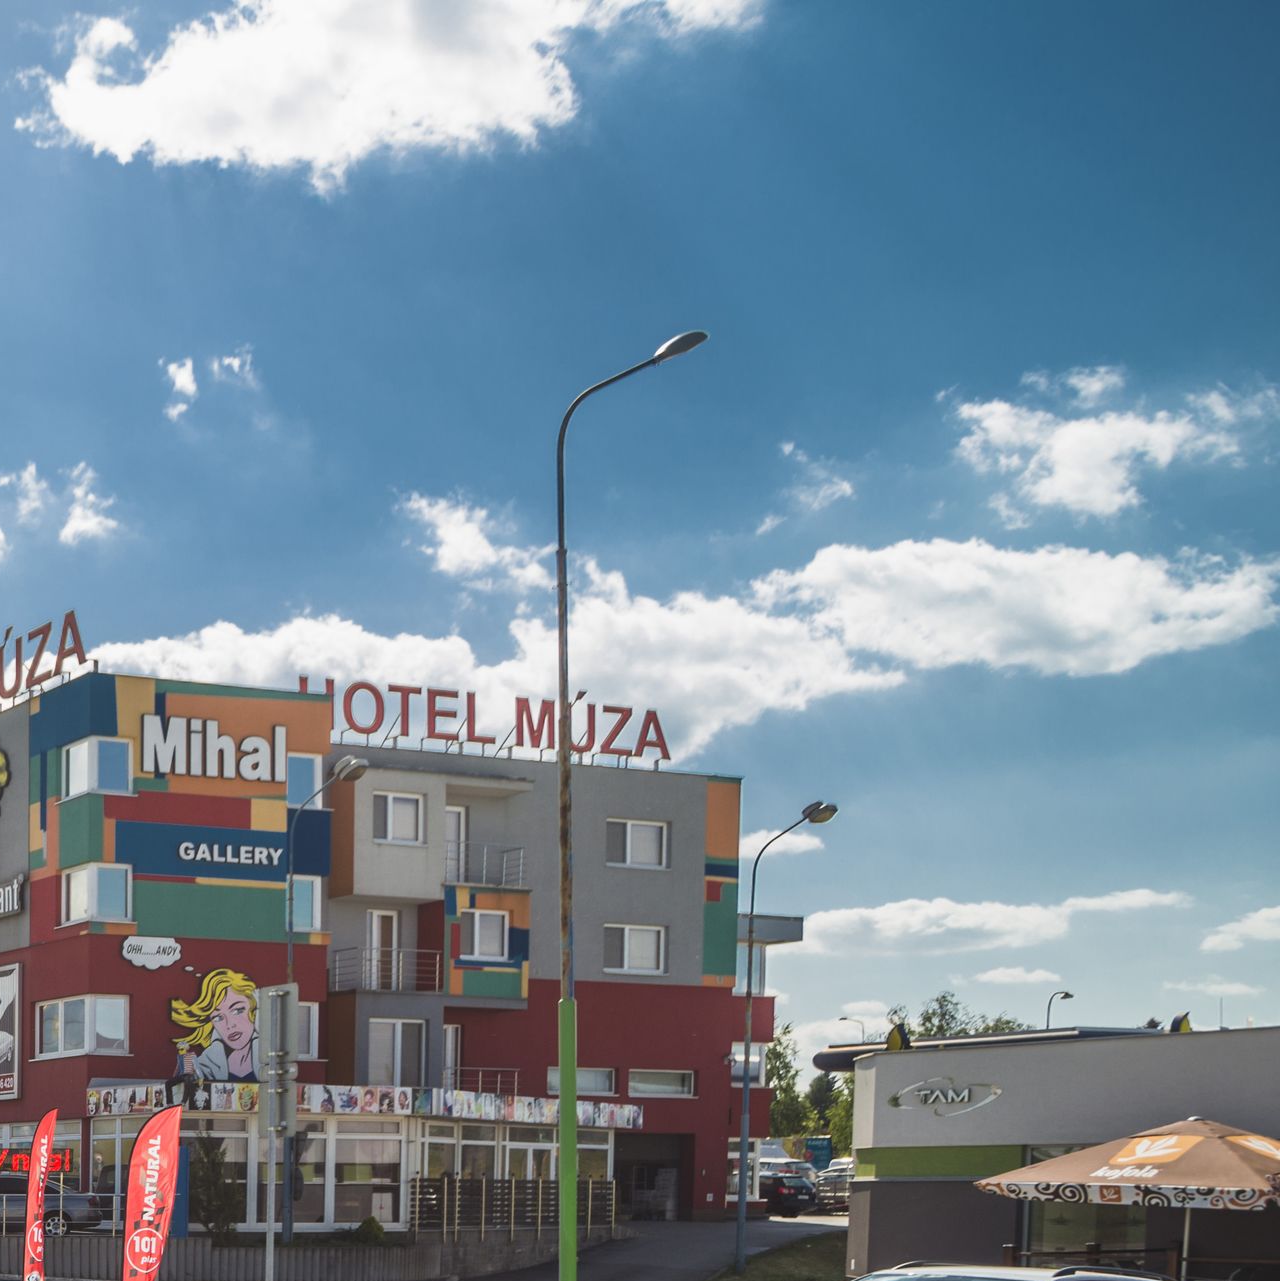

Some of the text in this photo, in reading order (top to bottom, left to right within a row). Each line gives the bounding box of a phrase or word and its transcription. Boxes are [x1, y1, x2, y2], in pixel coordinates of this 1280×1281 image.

[514, 689, 671, 761] MÚZA
[142, 714, 287, 783] Mihal
[178, 841, 284, 866] GALLERY
[4, 1077, 14, 1089] 420
[914, 1088, 970, 1104] TAM
[143, 1135, 161, 1221] NATURAL
[1090, 1165, 1160, 1180] kofola
[133, 1235, 157, 1254] 101
[141, 1255, 158, 1264] plus
